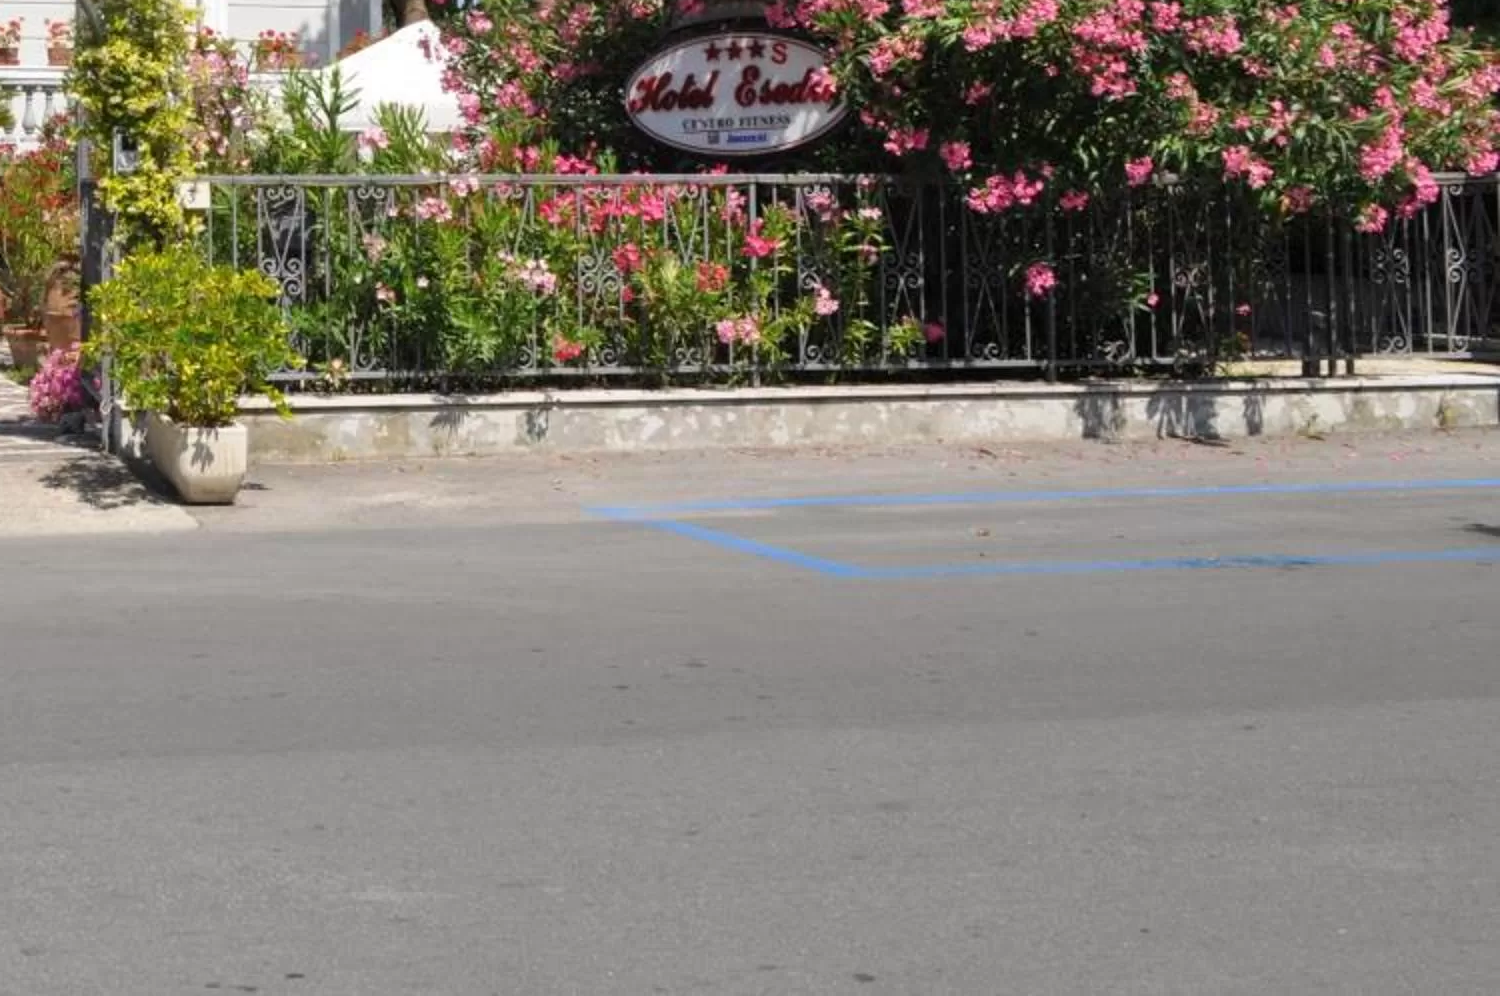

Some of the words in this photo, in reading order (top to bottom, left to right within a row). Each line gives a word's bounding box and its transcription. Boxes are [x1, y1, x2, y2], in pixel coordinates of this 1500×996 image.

[771, 42, 787, 64] S
[627, 70, 720, 113] Hotel
[682, 117, 734, 131] CENTRO
[739, 113, 791, 128] FITNESS
